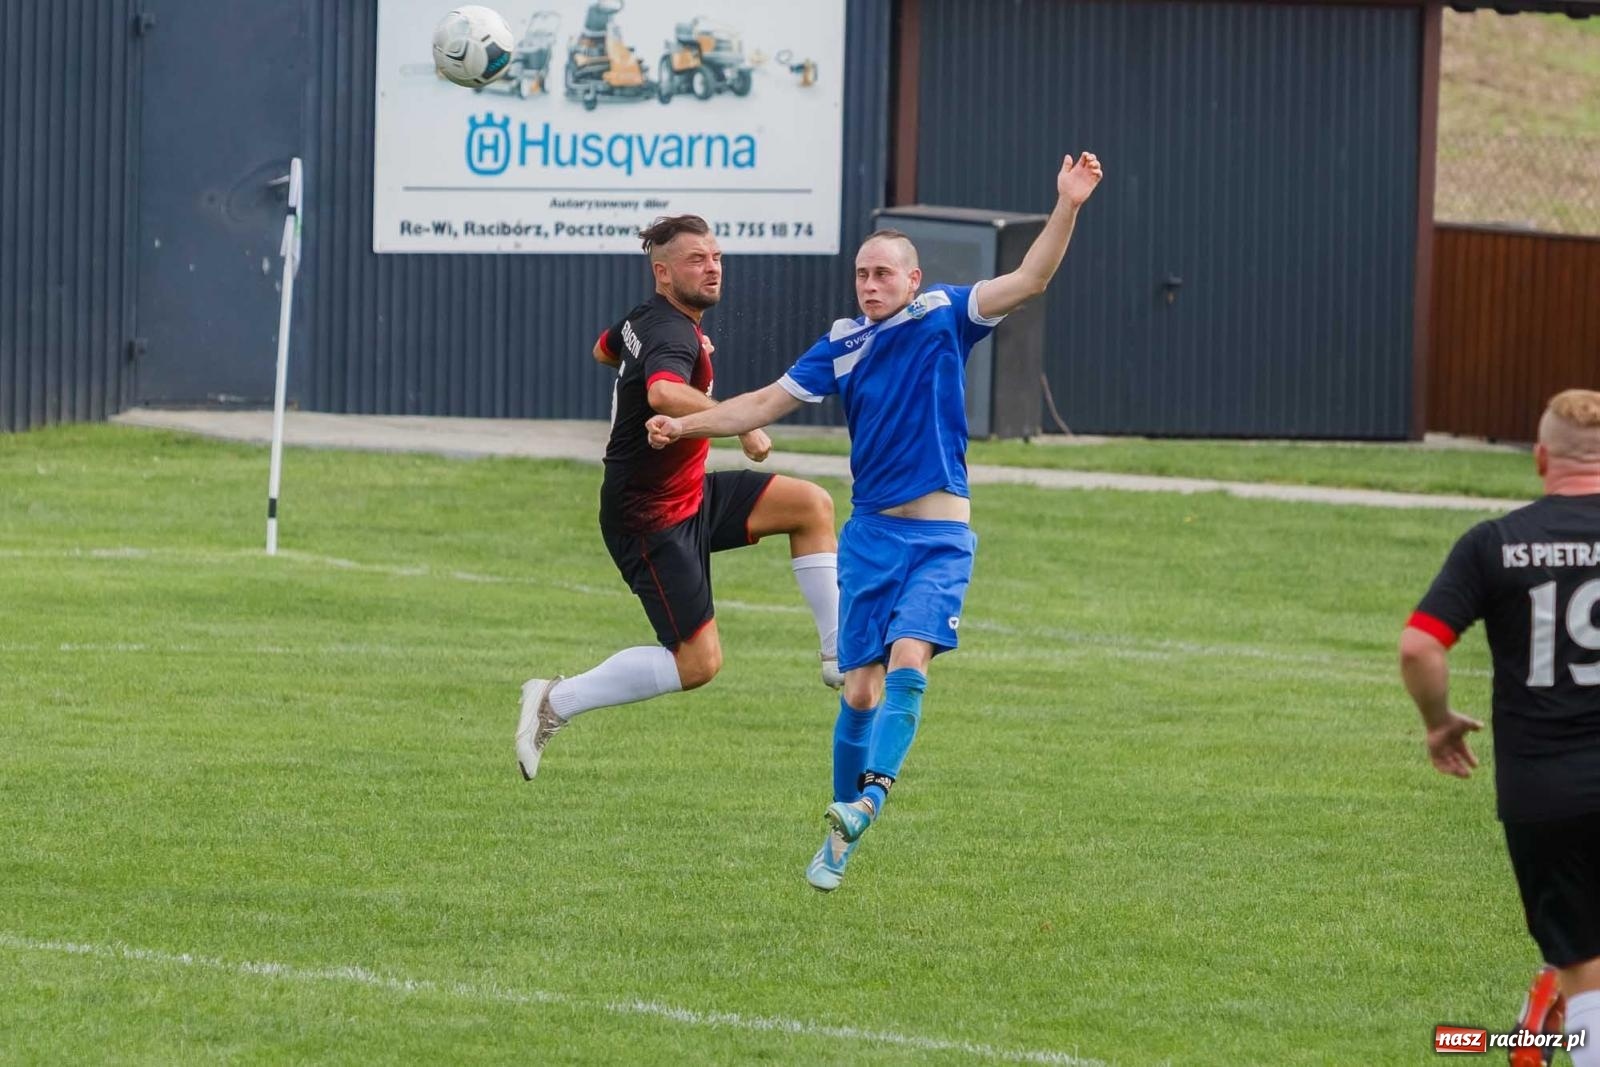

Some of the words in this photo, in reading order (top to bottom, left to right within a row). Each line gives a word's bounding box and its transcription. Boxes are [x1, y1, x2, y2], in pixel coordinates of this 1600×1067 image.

[518, 121, 756, 177] Husqvarna
[464, 219, 549, 238] Racibórz,
[738, 222, 765, 237] 755
[794, 222, 813, 237] 74
[1502, 543, 1530, 568] KS
